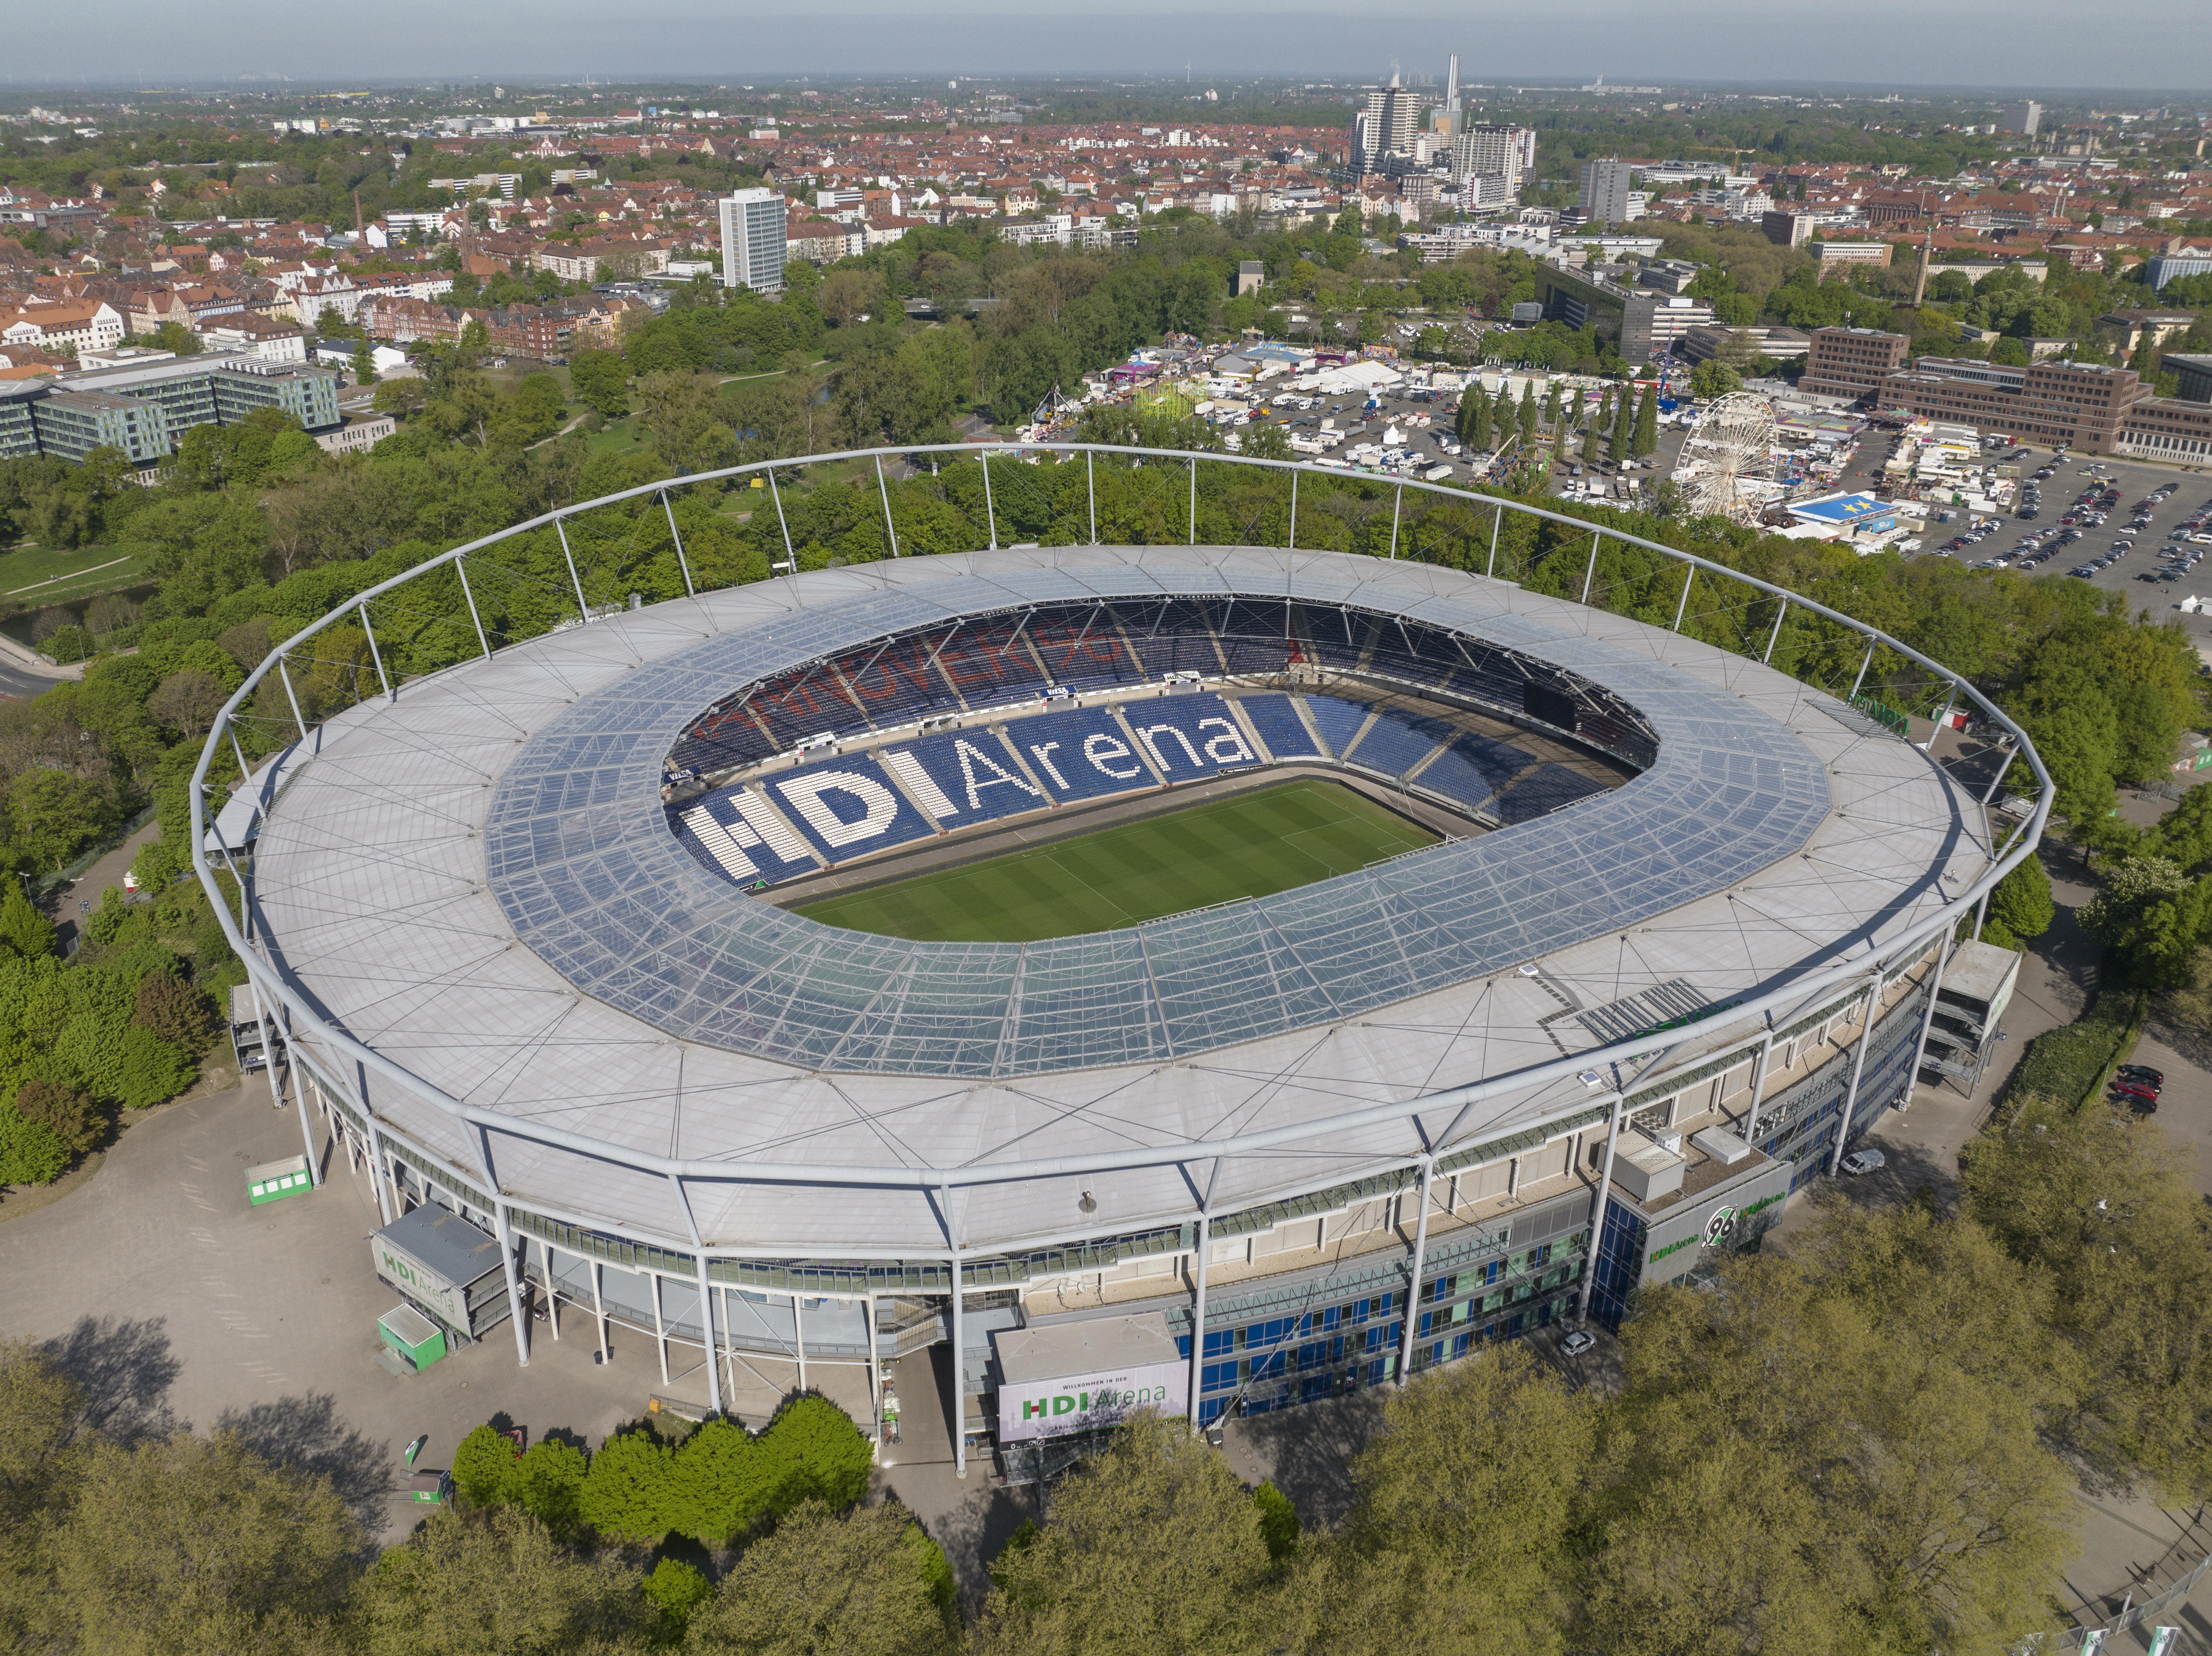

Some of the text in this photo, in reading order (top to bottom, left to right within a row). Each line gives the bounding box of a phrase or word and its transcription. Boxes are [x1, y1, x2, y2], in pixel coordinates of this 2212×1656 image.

[1047, 687, 1067, 695] VILSA
[669, 769, 693, 780] VILSA
[679, 717, 1255, 880] HDI Arena
[1739, 1191, 1786, 1219] HDI Arena
[1701, 1204, 1739, 1248] 96
[1649, 1233, 1699, 1264] HDI Arena
[383, 1251, 455, 1313] HDI Arena
[1063, 1380, 1104, 1390] WILLKOMMEN
[1023, 1385, 1165, 1420] HDI Arena
